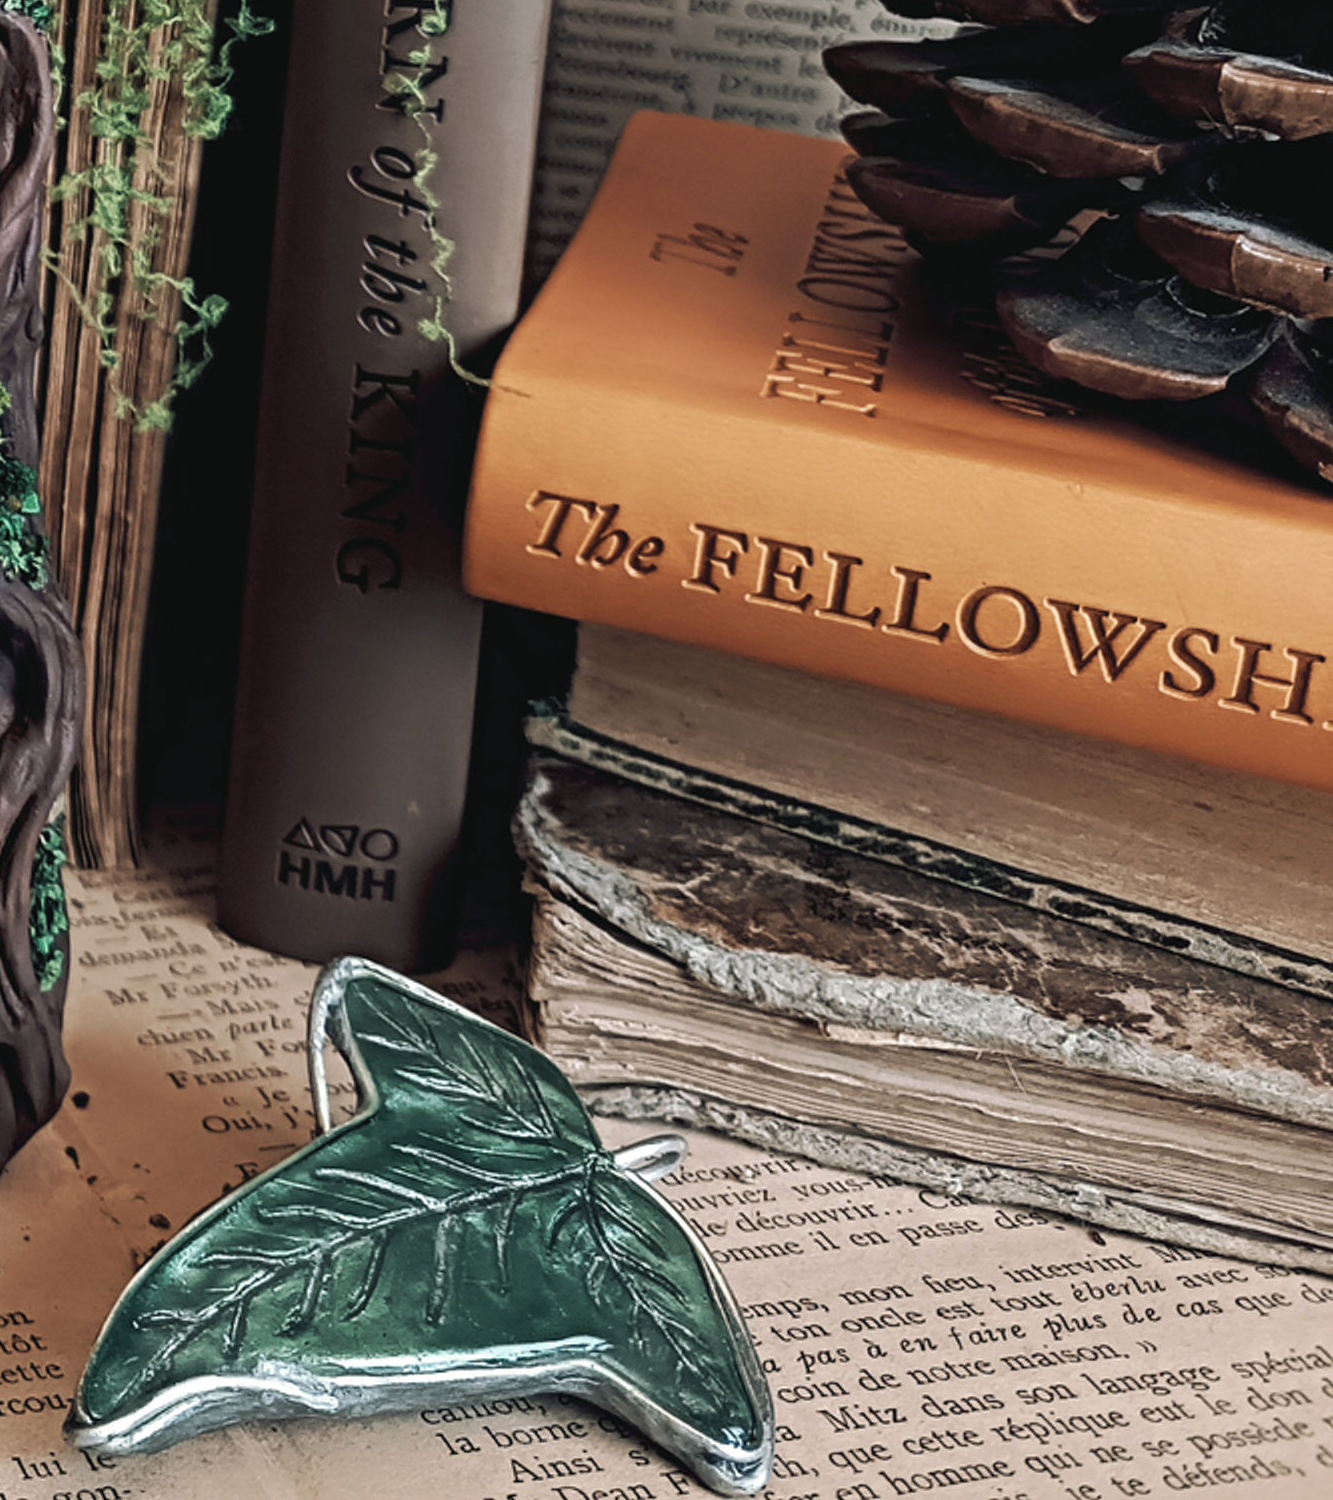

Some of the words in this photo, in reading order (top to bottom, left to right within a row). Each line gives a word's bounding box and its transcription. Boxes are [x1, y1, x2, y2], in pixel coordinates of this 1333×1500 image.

[347, 144, 437, 231] of
[356, 232, 426, 338] the
[336, 362, 422, 595] KING
[526, 490, 665, 577] The
[683, 521, 1333, 731] FELLOWSH
[276, 851, 397, 901] HMH
[715, 1240, 803, 1264] omme
[808, 1231, 840, 1250] il
[849, 1231, 889, 1247] en
[898, 1216, 982, 1246] passe
[995, 1209, 1048, 1230] des
[736, 1200, 913, 1233] découvrir...
[743, 1295, 830, 1320] emps,
[840, 1283, 913, 1305] mon
[922, 1273, 996, 1294] fieu,
[1000, 1252, 1141, 1283] intervint
[797, 1347, 850, 1374] pas
[867, 1338, 887, 1360] à
[900, 1338, 937, 1354] en
[948, 1323, 1026, 1350] faire
[1044, 1312, 1107, 1341] plus
[1123, 1303, 1161, 1325] de
[1176, 1300, 1223, 1317] cas
[1235, 1292, 1292, 1317] que
[777, 1375, 849, 1404] coin
[858, 1369, 901, 1392] de
[907, 1358, 995, 1386] notre
[1001, 1343, 1130, 1372] maison.
[817, 1404, 906, 1433] Mitz
[921, 1392, 1005, 1418] dans
[1016, 1382, 1078, 1405] son
[1080, 1365, 1220, 1396] langage
[435, 1432, 481, 1456] la
[483, 1418, 589, 1449] borne
[829, 1443, 893, 1473] que
[902, 1425, 984, 1456] cette
[991, 1410, 1131, 1445] réplique
[1140, 1400, 1195, 1423] eut
[1195, 1394, 1237, 1415] le
[1247, 1386, 1312, 1411] don
[13, 1452, 67, 1480] lui
[80, 1449, 117, 1471] le
[510, 1450, 604, 1483] Ainsi
[1111, 1476, 1151, 1497] te
[1162, 1455, 1306, 1491] défends,
